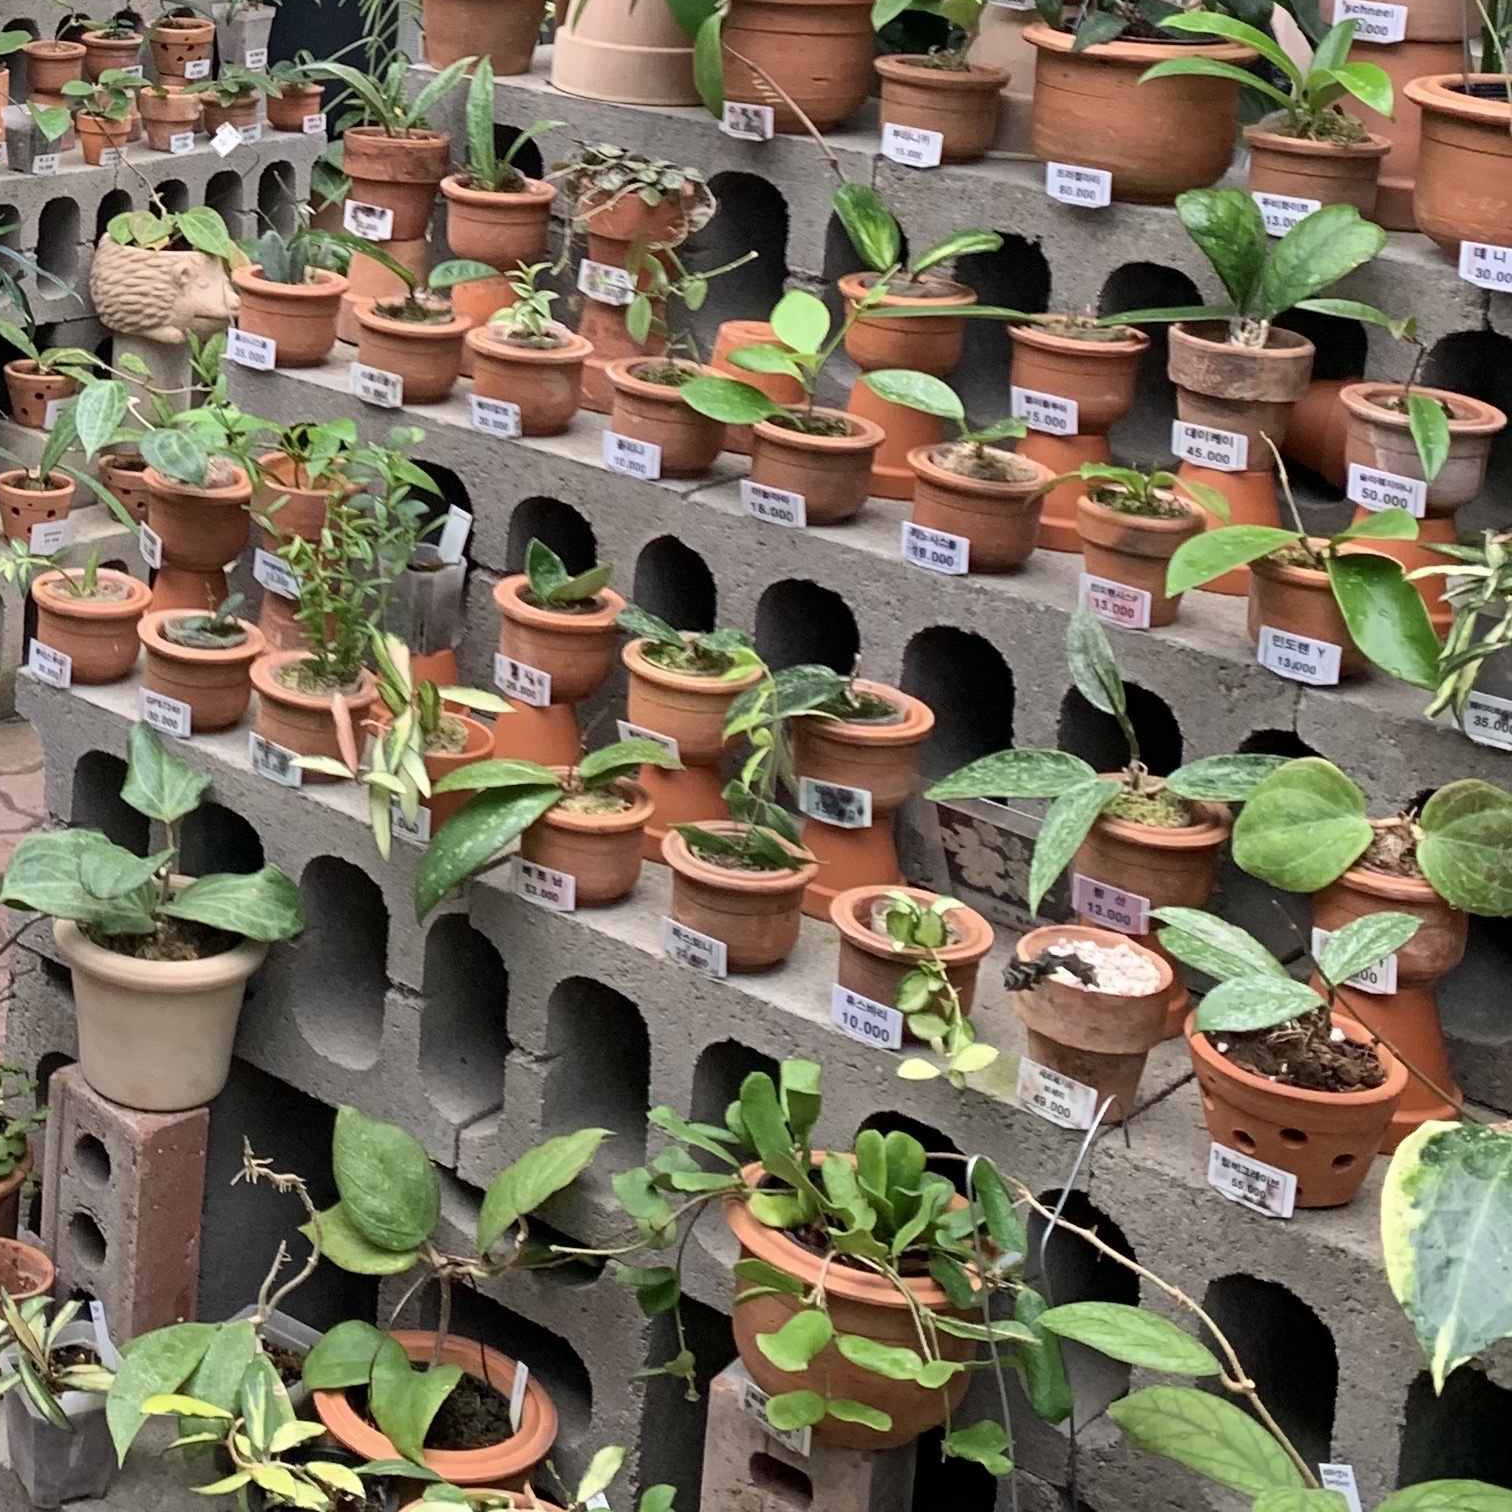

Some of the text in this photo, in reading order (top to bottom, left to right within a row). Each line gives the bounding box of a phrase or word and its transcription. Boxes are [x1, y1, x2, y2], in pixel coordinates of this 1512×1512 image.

[1265, 215, 1299, 230] 13.00
[1186, 445, 1231, 466] 45.000
[1361, 486, 1409, 510] 50.000
[1092, 597, 1135, 619] 13.000
[1271, 633, 1311, 656] 민도렌
[1086, 901, 1132, 927] 13.000
[841, 1010, 891, 1044] 10.000
